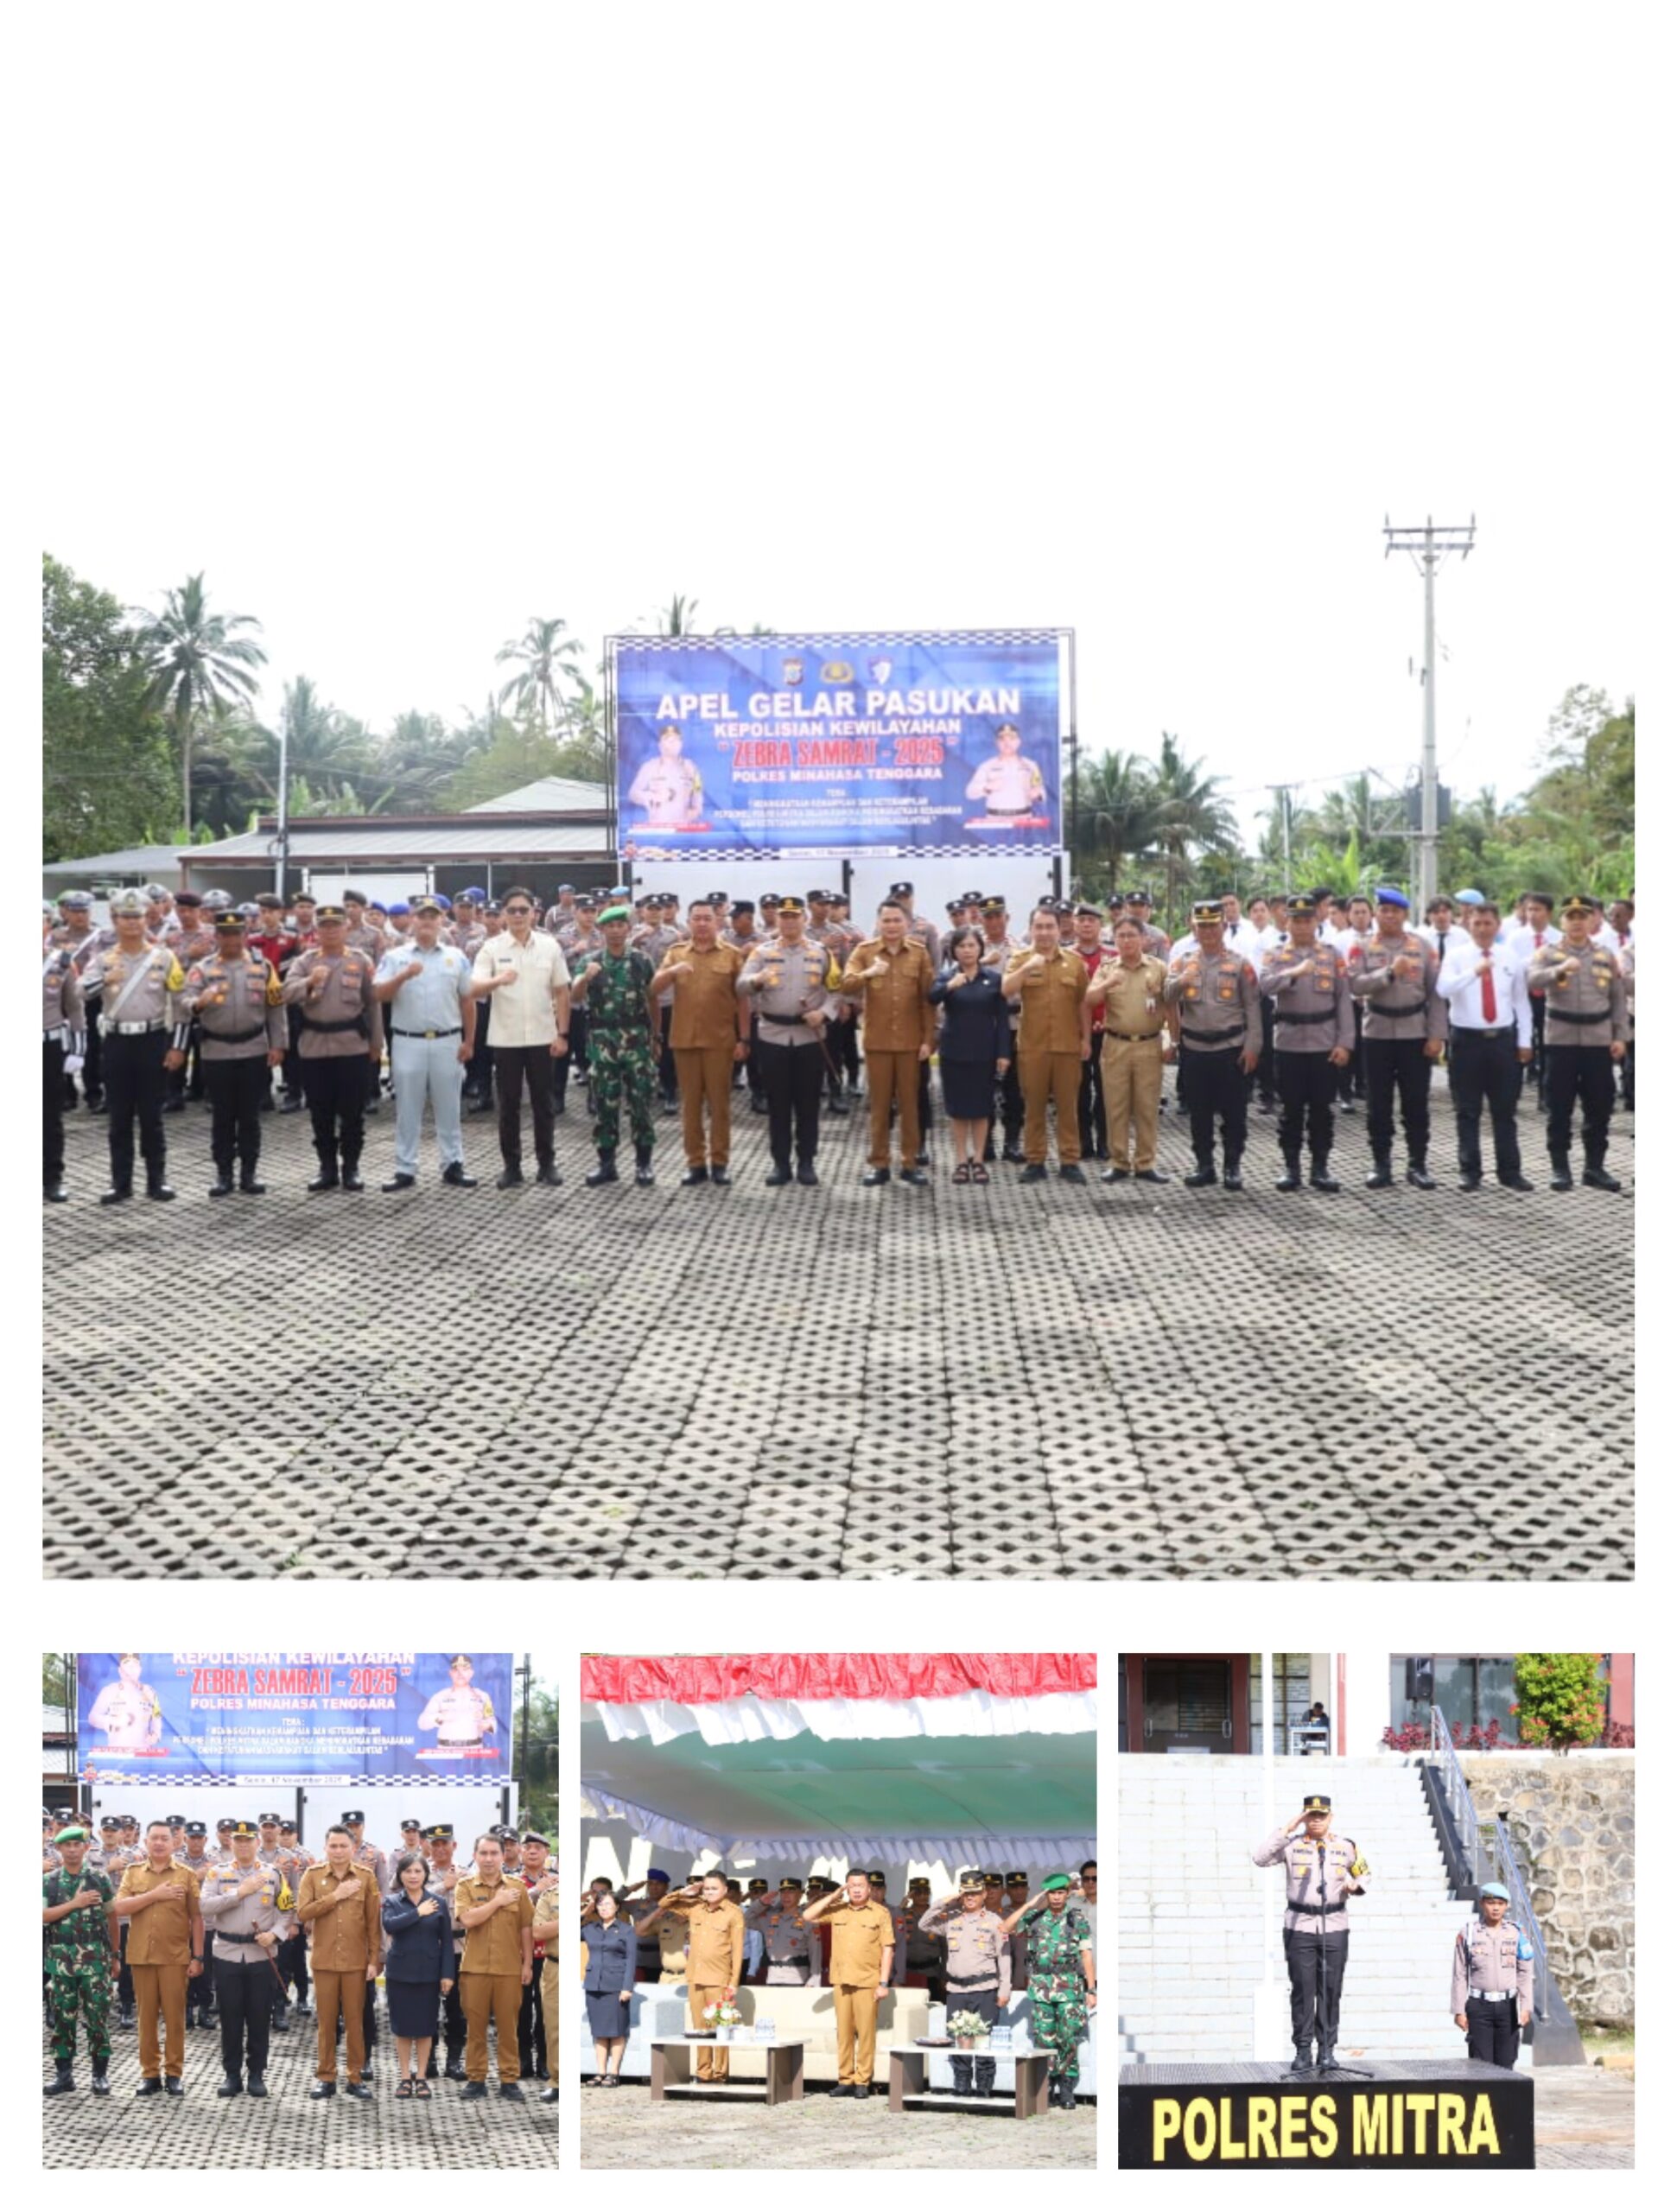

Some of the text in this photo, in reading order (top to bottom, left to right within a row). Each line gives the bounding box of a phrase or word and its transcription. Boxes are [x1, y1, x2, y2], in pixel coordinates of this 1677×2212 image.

[656, 688, 1020, 719] APEL GELAR PASUKAN
[715, 718, 961, 738] KEPOLISIAN KEWILAYAHAN
[733, 740, 791, 767] ZEBRA
[797, 737, 877, 766] SAMRAT
[893, 737, 944, 765] 2025
[733, 767, 943, 783] POLRES MINAHASA TENGGARA
[173, 1653, 415, 1664] KEPOLISIAN KEWILAYAHAN
[191, 1668, 250, 1694] ZEBRA
[253, 1668, 333, 1694] SAMRAT
[349, 1668, 397, 1694] 2025
[190, 1698, 396, 1710] POLRES MINAHASA TENGGARA
[1153, 2093, 1502, 2162] POLRES MITRA
